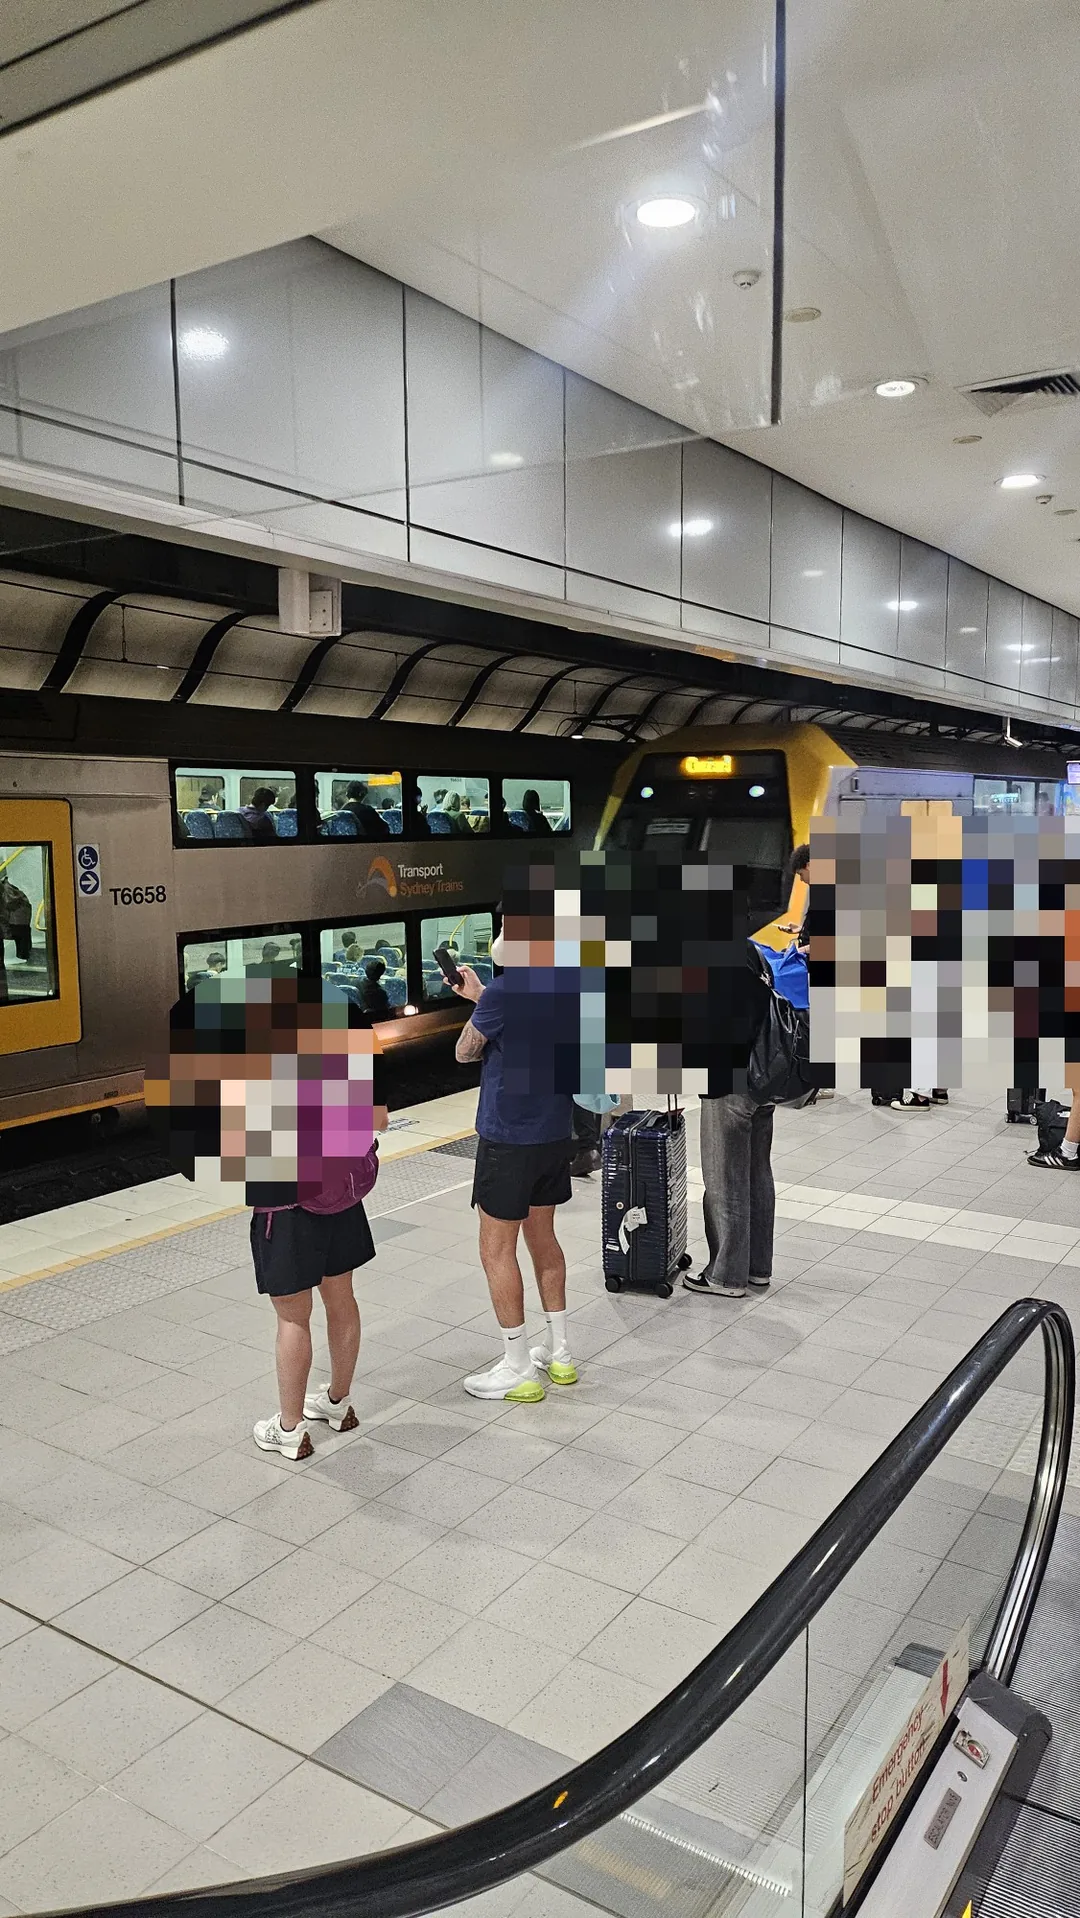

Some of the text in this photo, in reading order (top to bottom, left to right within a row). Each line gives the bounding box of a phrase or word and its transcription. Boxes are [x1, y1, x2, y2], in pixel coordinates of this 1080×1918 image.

[398, 863, 443, 879] Transport
[109, 885, 167, 906] T6658
[400, 879, 463, 897] Sydney Trains
[872, 1706, 924, 1804] Emergency
[872, 1737, 926, 1843] stop button
